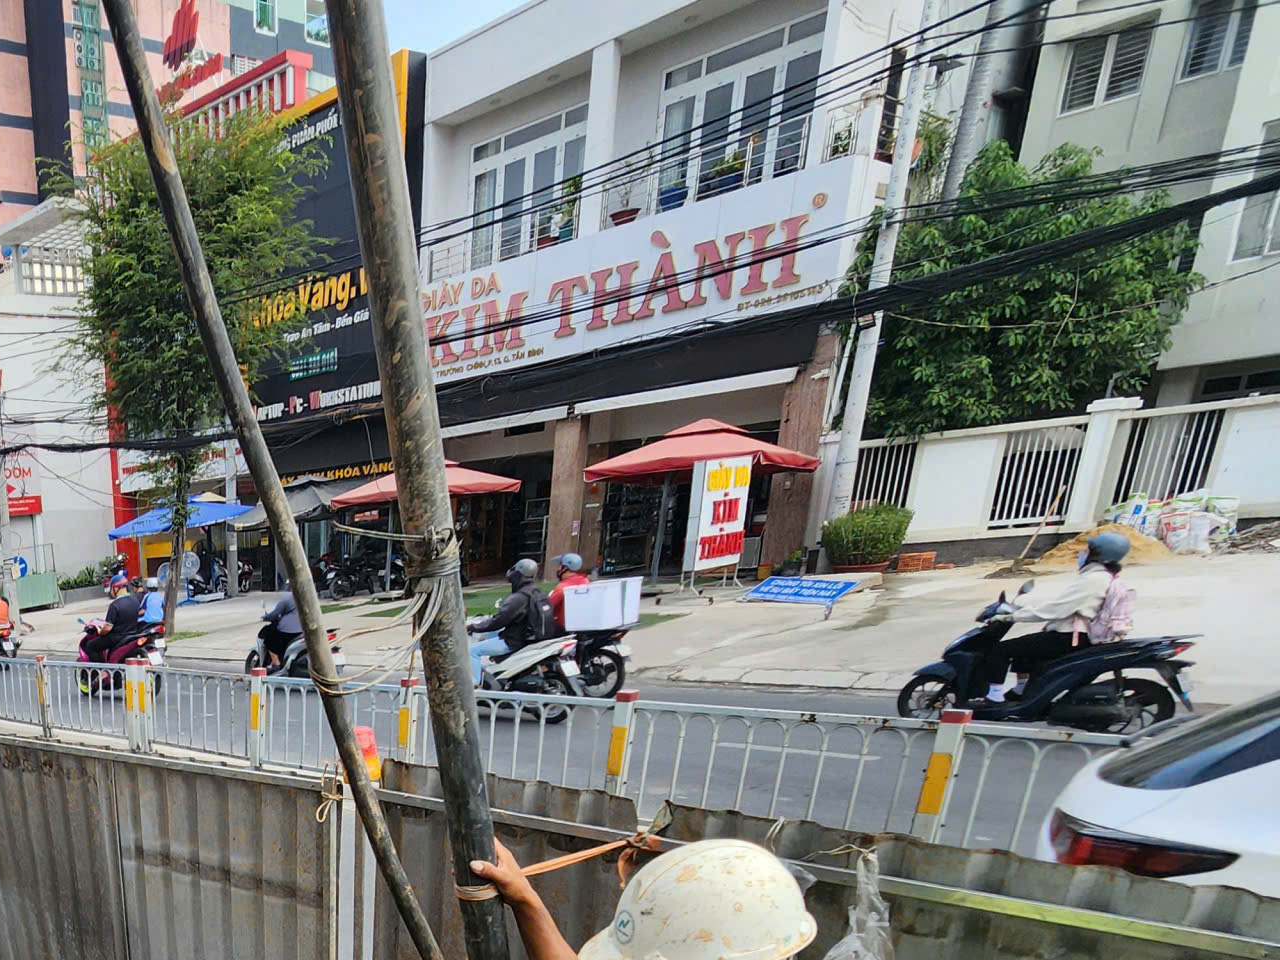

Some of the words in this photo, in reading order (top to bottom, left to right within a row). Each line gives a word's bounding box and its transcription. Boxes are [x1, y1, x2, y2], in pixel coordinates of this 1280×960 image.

[316, 108, 339, 135] PHỐI
[425, 290, 528, 368] KIM
[548, 211, 809, 339] THÀNH
[471, 272, 501, 300] DA
[327, 465, 361, 480] KHÓA
[711, 494, 741, 526] KIM
[699, 528, 745, 561] THÀNH
